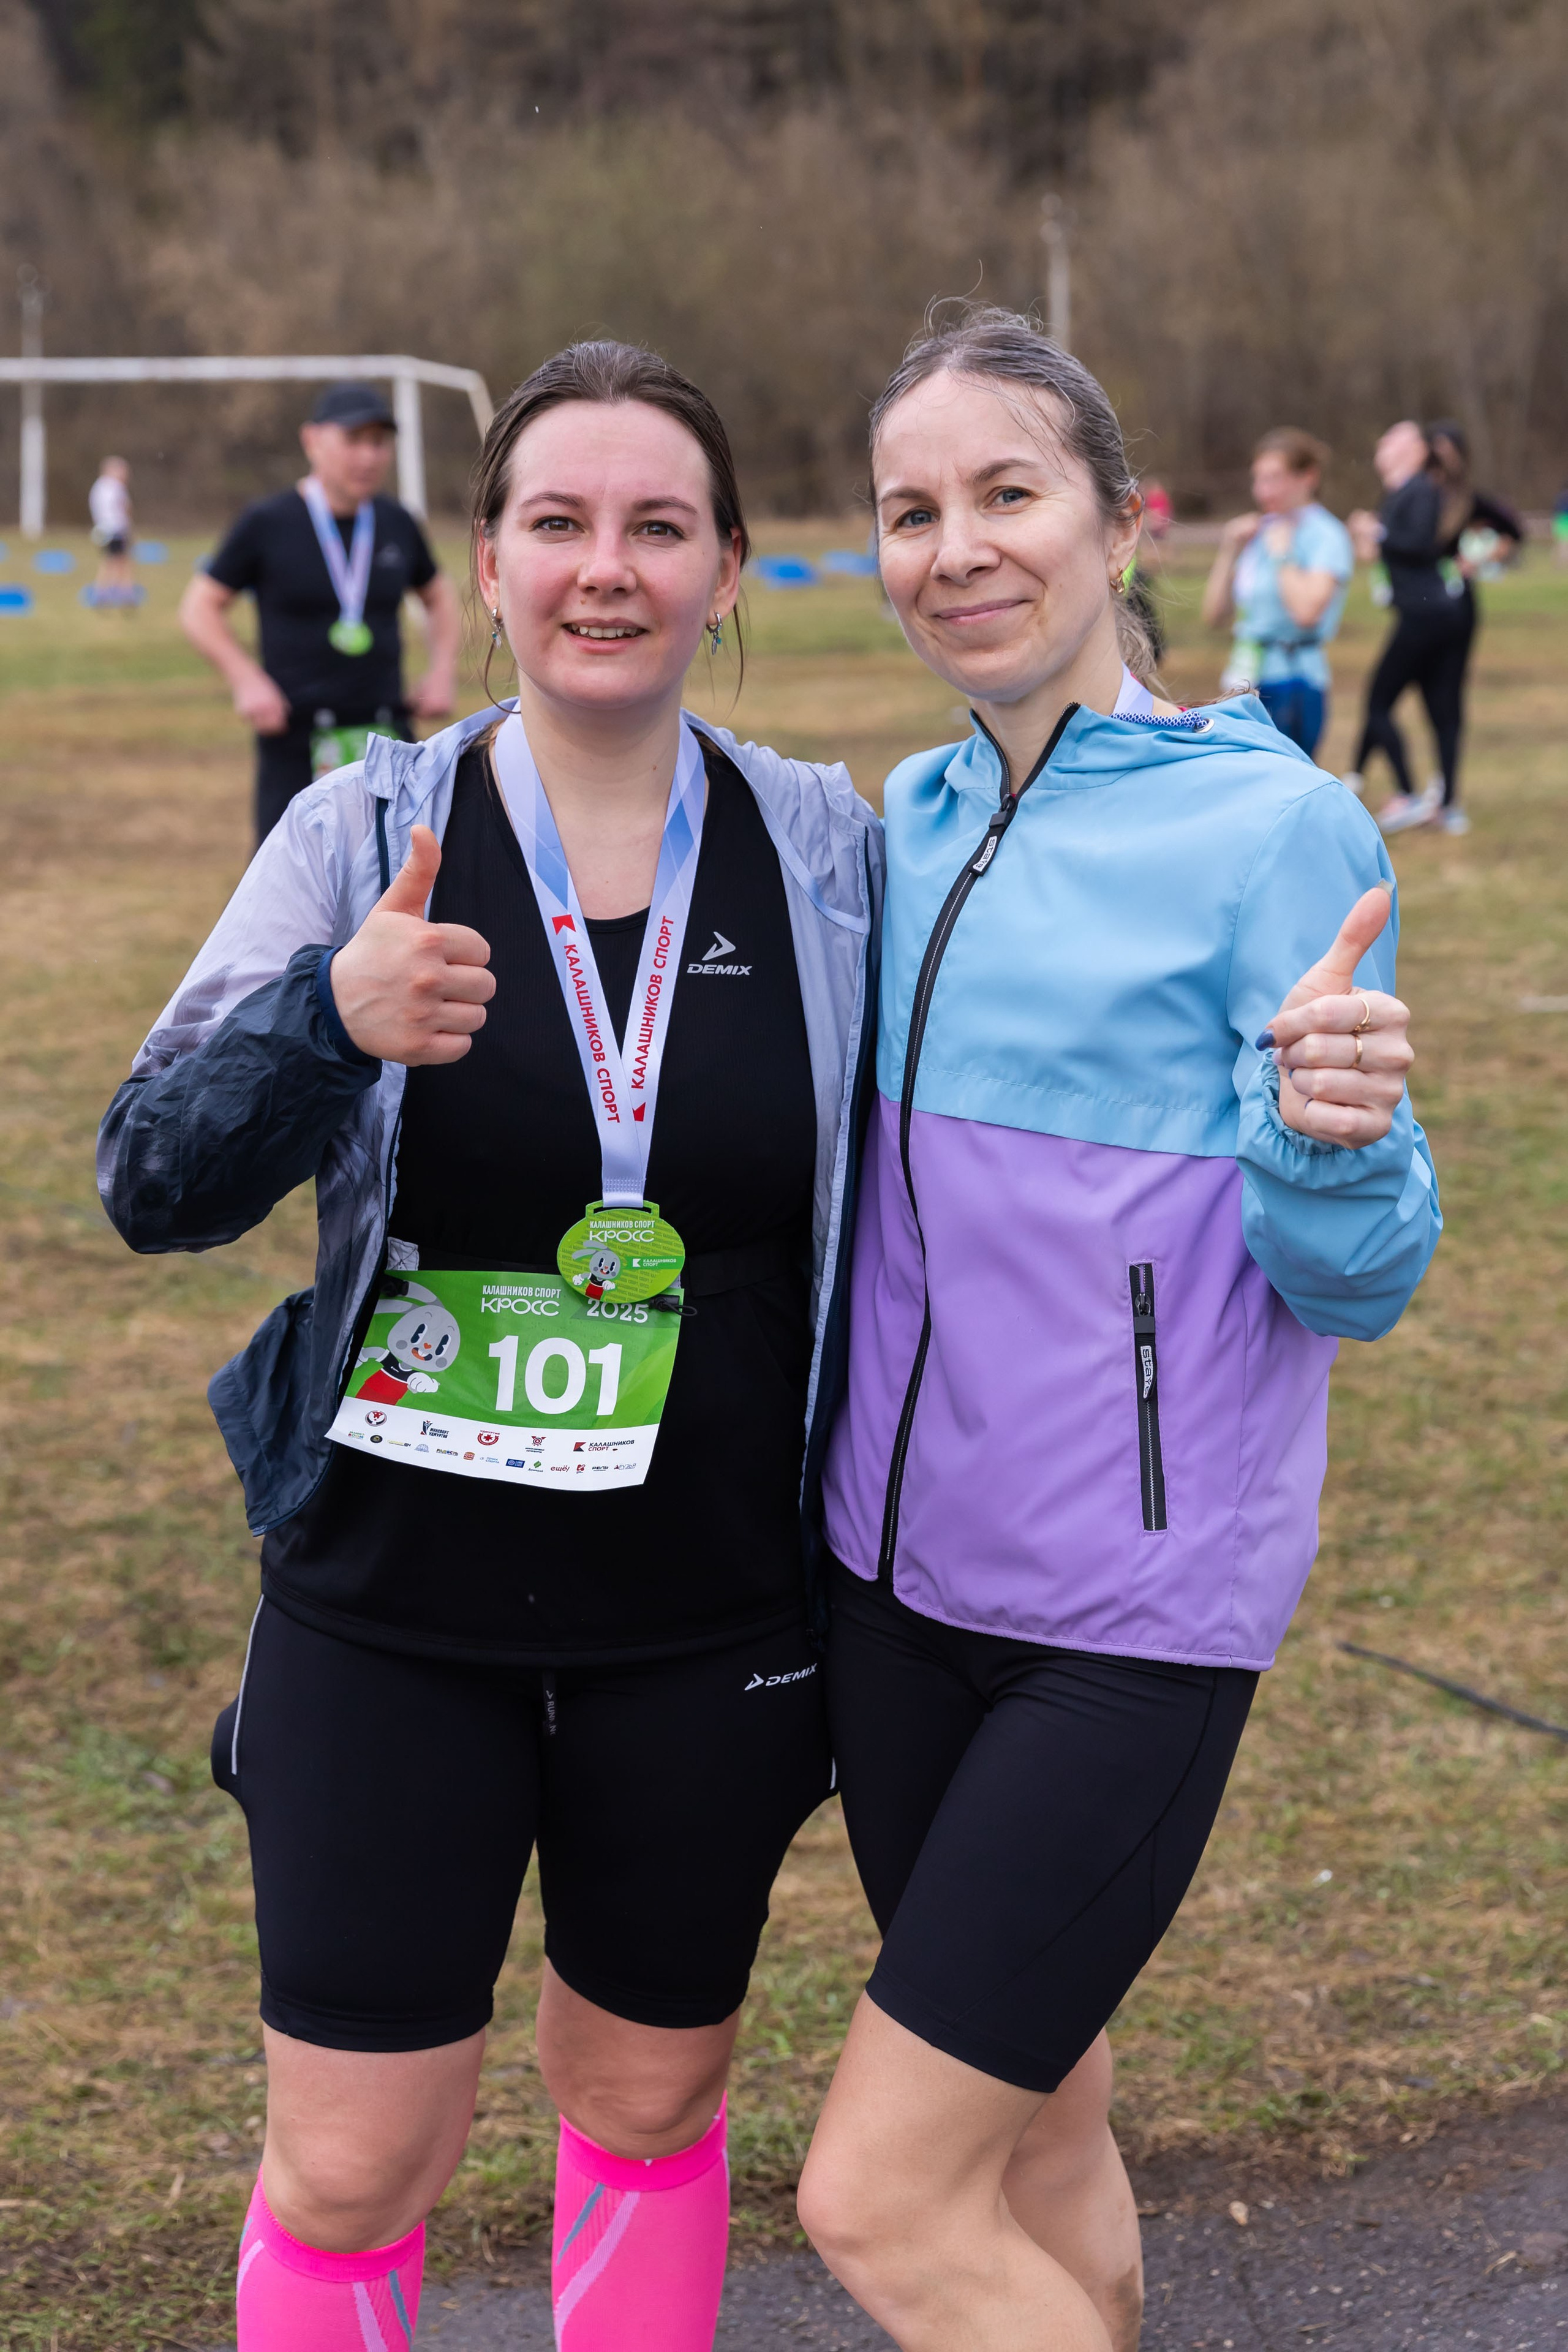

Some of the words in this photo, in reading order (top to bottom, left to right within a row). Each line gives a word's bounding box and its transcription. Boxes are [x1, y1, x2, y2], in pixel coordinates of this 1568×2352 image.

[687, 963, 753, 976] DEMIX
[631, 974, 663, 1090] КАЛАШНИКОВ
[653, 915, 674, 969] СПОРТ
[564, 944, 606, 1063] КАЛАШНИКОВ
[597, 1068, 620, 1123] СПОРТ
[635, 1220, 655, 1229] СПОРТ
[589, 1230, 655, 1243] КРОСС
[482, 1285, 534, 1298] КАЛАШНИКОВ
[535, 1288, 562, 1298] СПОРТ
[481, 1297, 560, 1317] КРОСС
[587, 1299, 649, 1324] 2025
[488, 1335, 623, 1416] 101
[765, 1662, 818, 1686] DEMIX
